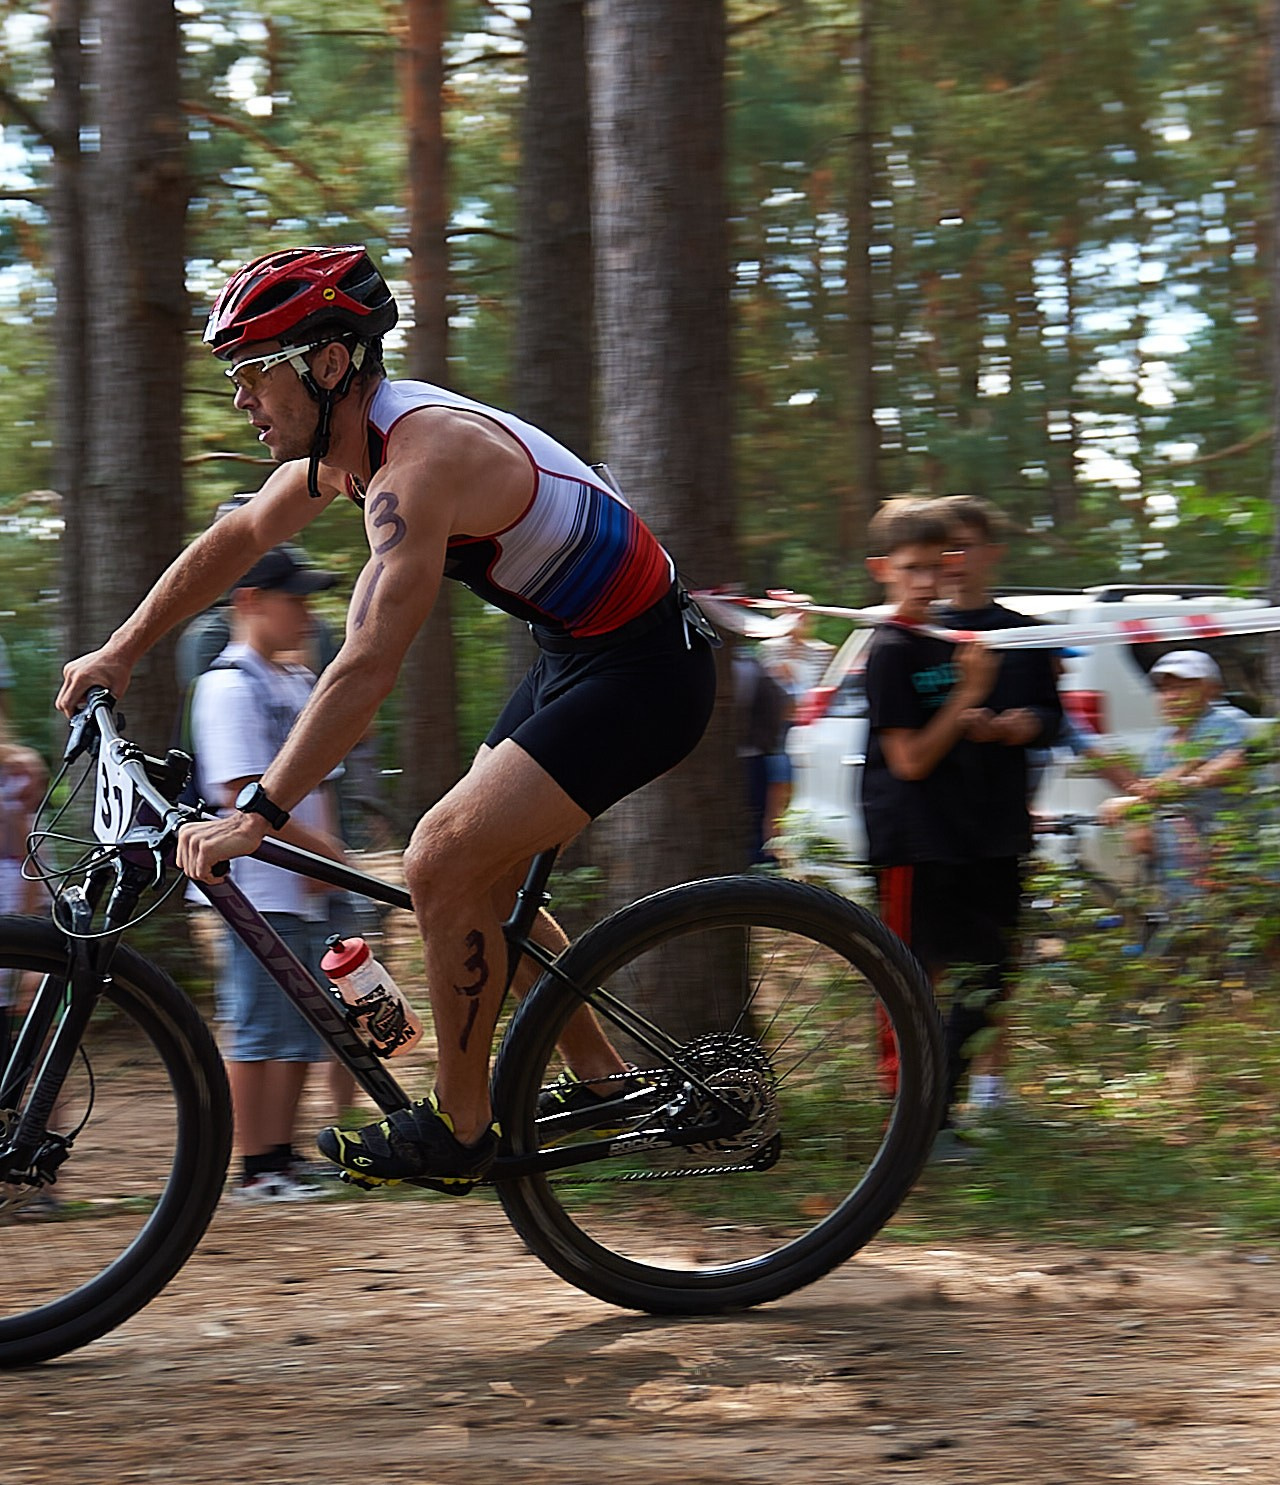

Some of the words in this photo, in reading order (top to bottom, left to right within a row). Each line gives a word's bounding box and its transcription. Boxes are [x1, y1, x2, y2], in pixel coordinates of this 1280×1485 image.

[101, 762, 123, 839] 31
[210, 882, 405, 1109] PARDUS
[20, 1069, 65, 1143] ROCKSHOX
